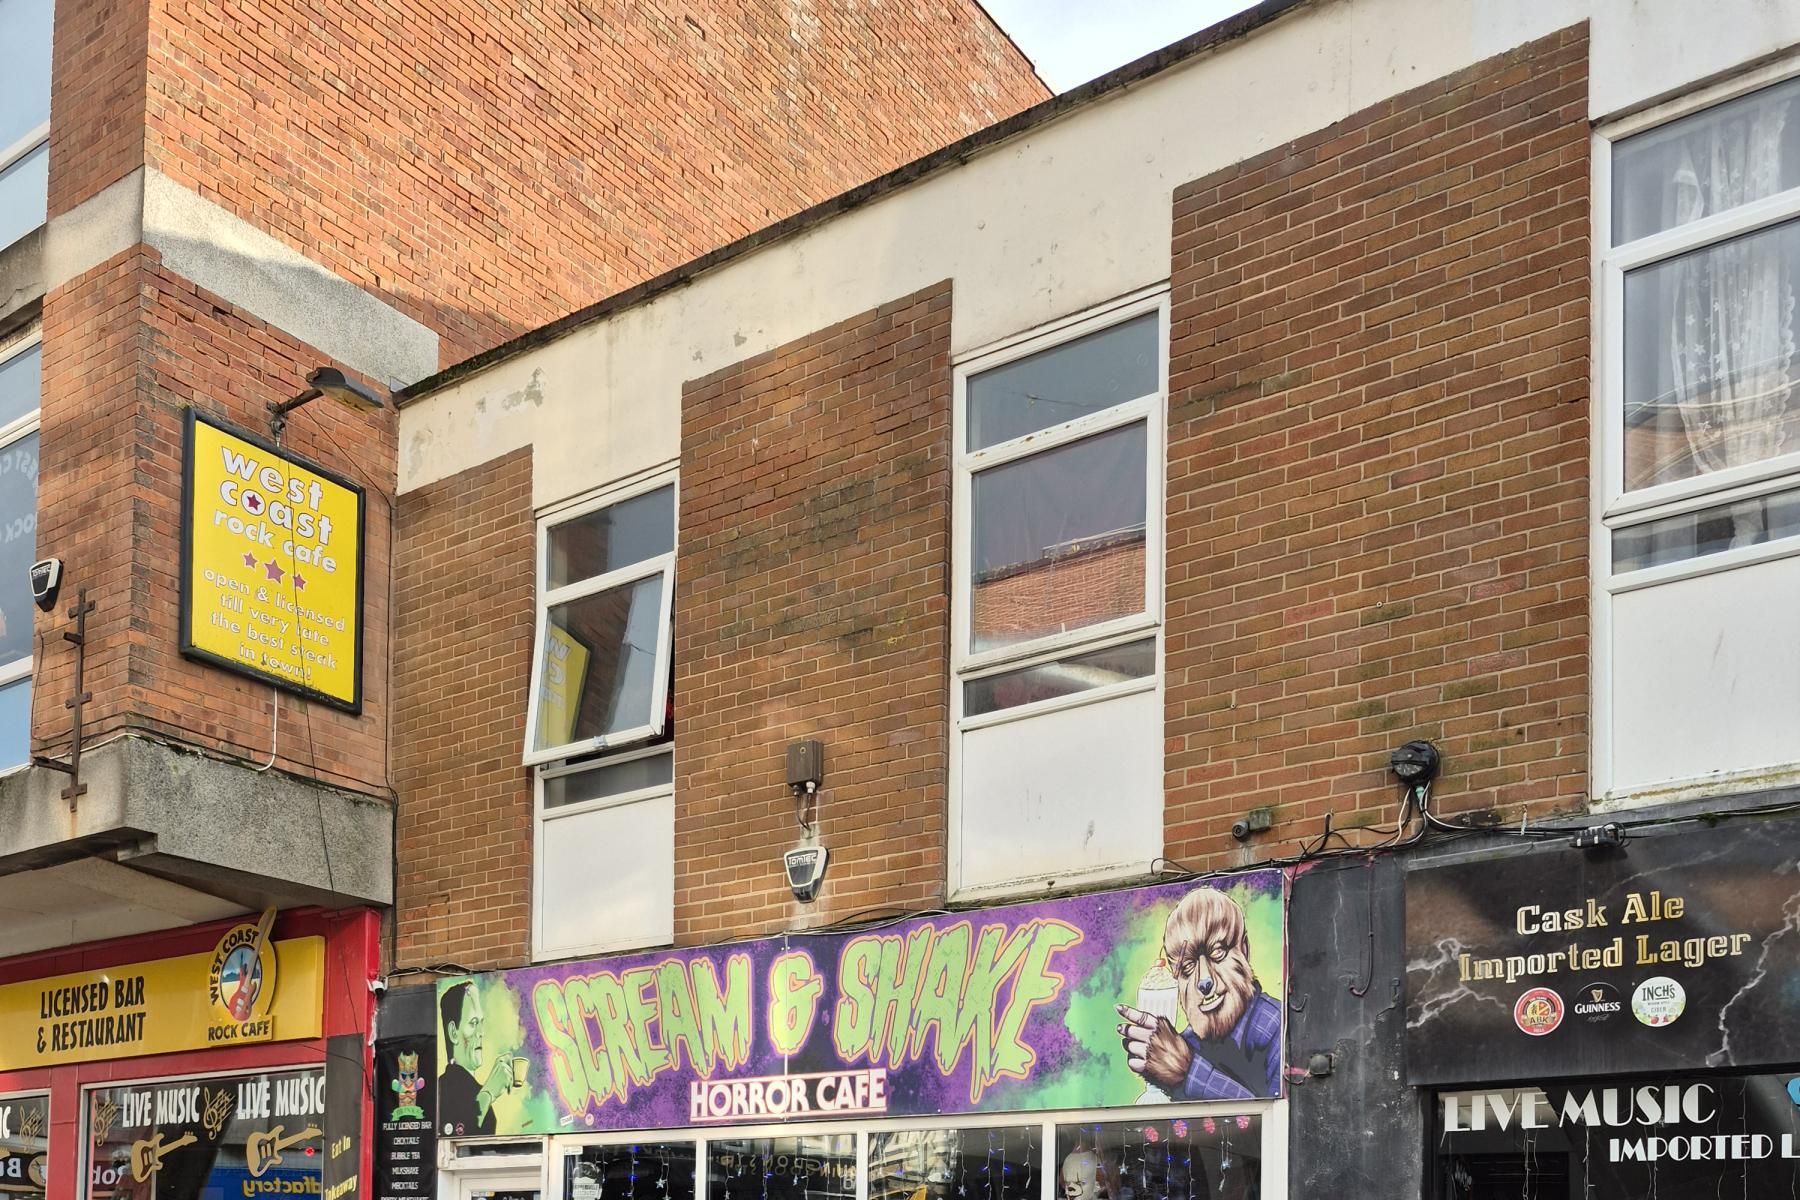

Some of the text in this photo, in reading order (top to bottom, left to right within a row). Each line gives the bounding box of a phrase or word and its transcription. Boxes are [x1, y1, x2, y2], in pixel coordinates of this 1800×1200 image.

[221, 446, 323, 511] west
[220, 480, 333, 545] coast
[214, 509, 337, 573] rock cafe
[204, 569, 345, 631] open & licensed
[221, 594, 329, 646] till very late
[211, 612, 337, 669] the best steak
[240, 643, 255, 660] in
[1516, 890, 1685, 935] Cask Ale
[210, 928, 259, 1006] WEST COAST
[1458, 932, 1752, 984] Imported Lager
[40, 976, 145, 1019] LICENSED BAR
[533, 918, 1084, 1116] SCREAM & SHAKE
[1574, 1002, 1621, 1014] GUINNESS
[36, 1012, 146, 1054] & RESTAURANT
[208, 1020, 270, 1041] ROCK CAFE
[122, 1087, 200, 1128] LIVE MUSIC
[237, 1076, 325, 1120] LIVE MUSIC
[690, 1070, 886, 1118] HORROR CAFE
[1444, 1084, 1716, 1132] LIVE MUSIC
[332, 1136, 351, 1159] Eat In
[1610, 1134, 1773, 1162] IMPORTED
